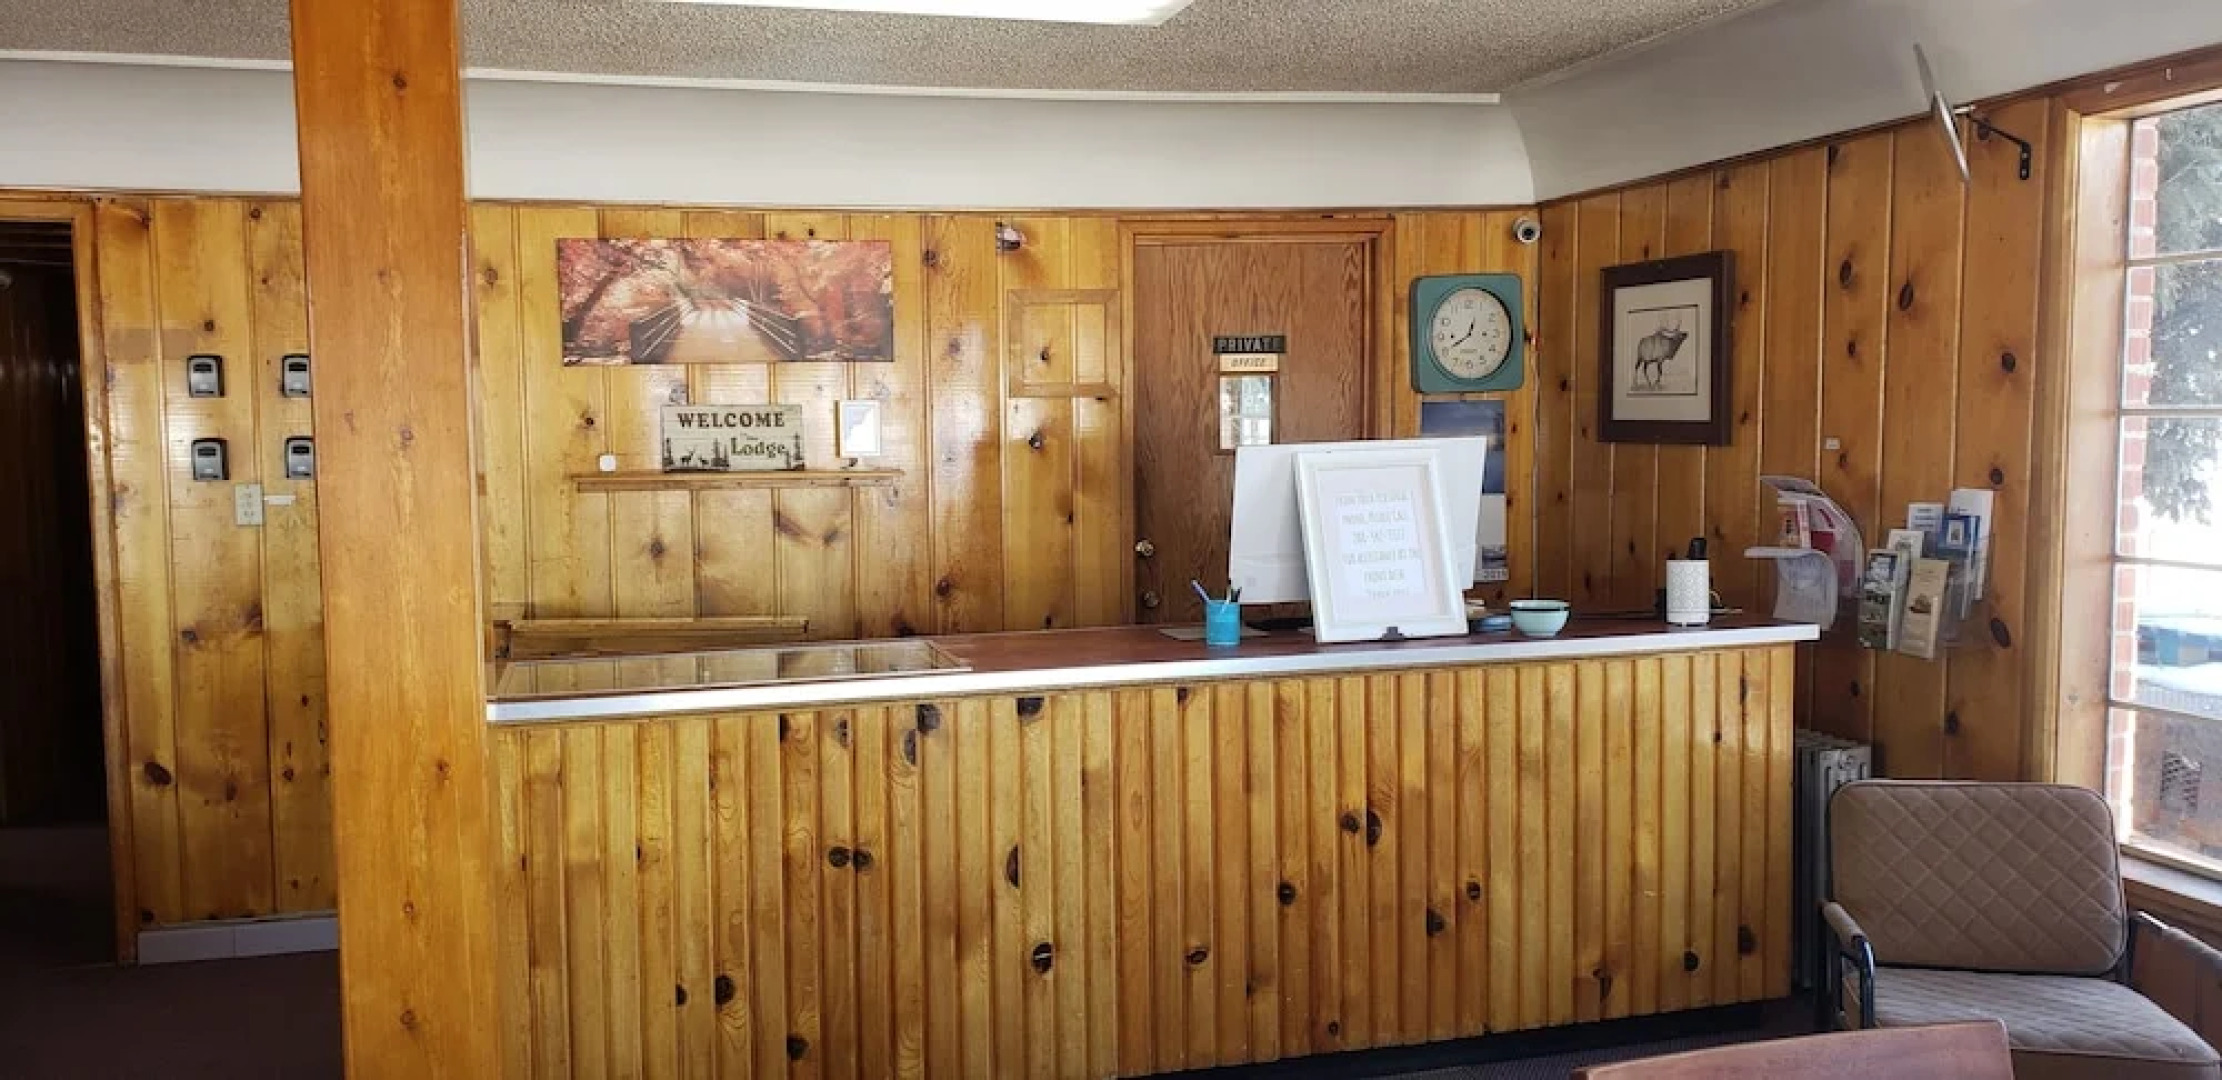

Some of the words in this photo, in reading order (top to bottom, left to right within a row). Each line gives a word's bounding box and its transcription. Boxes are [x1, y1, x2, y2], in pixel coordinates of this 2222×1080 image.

[1217, 337, 1282, 352] PRIVATE
[677, 412, 785, 428] WELCOME
[731, 437, 786, 459] Lodge
